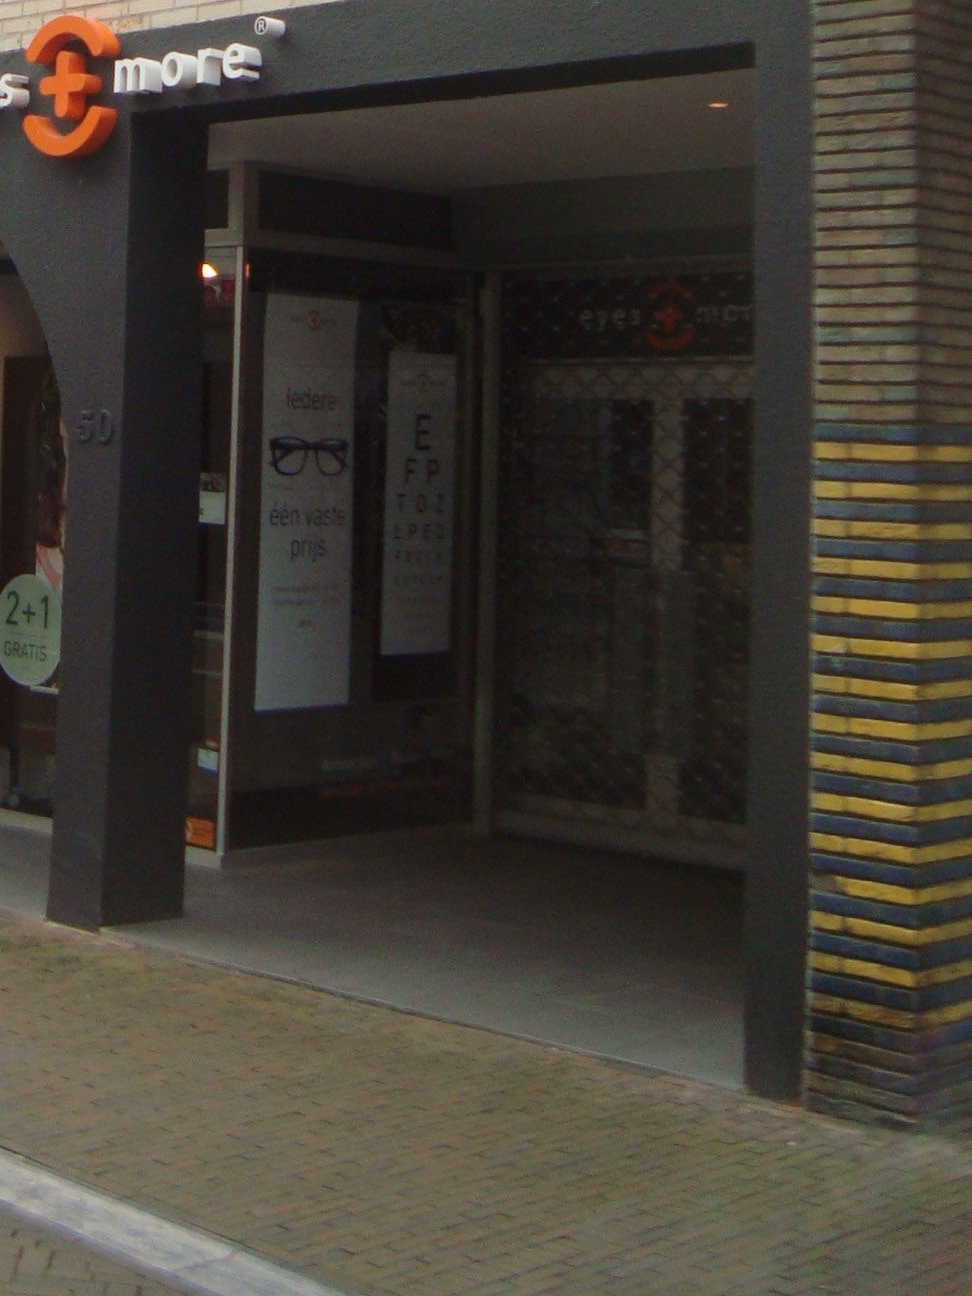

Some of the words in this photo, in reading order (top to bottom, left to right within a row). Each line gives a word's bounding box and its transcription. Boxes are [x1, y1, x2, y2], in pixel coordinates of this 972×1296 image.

[113, 42, 263, 93] more
[76, 409, 114, 445] 50
[415, 414, 431, 451] E
[5, 590, 49, 629] 2+1
[3, 640, 48, 662] GRATIS
